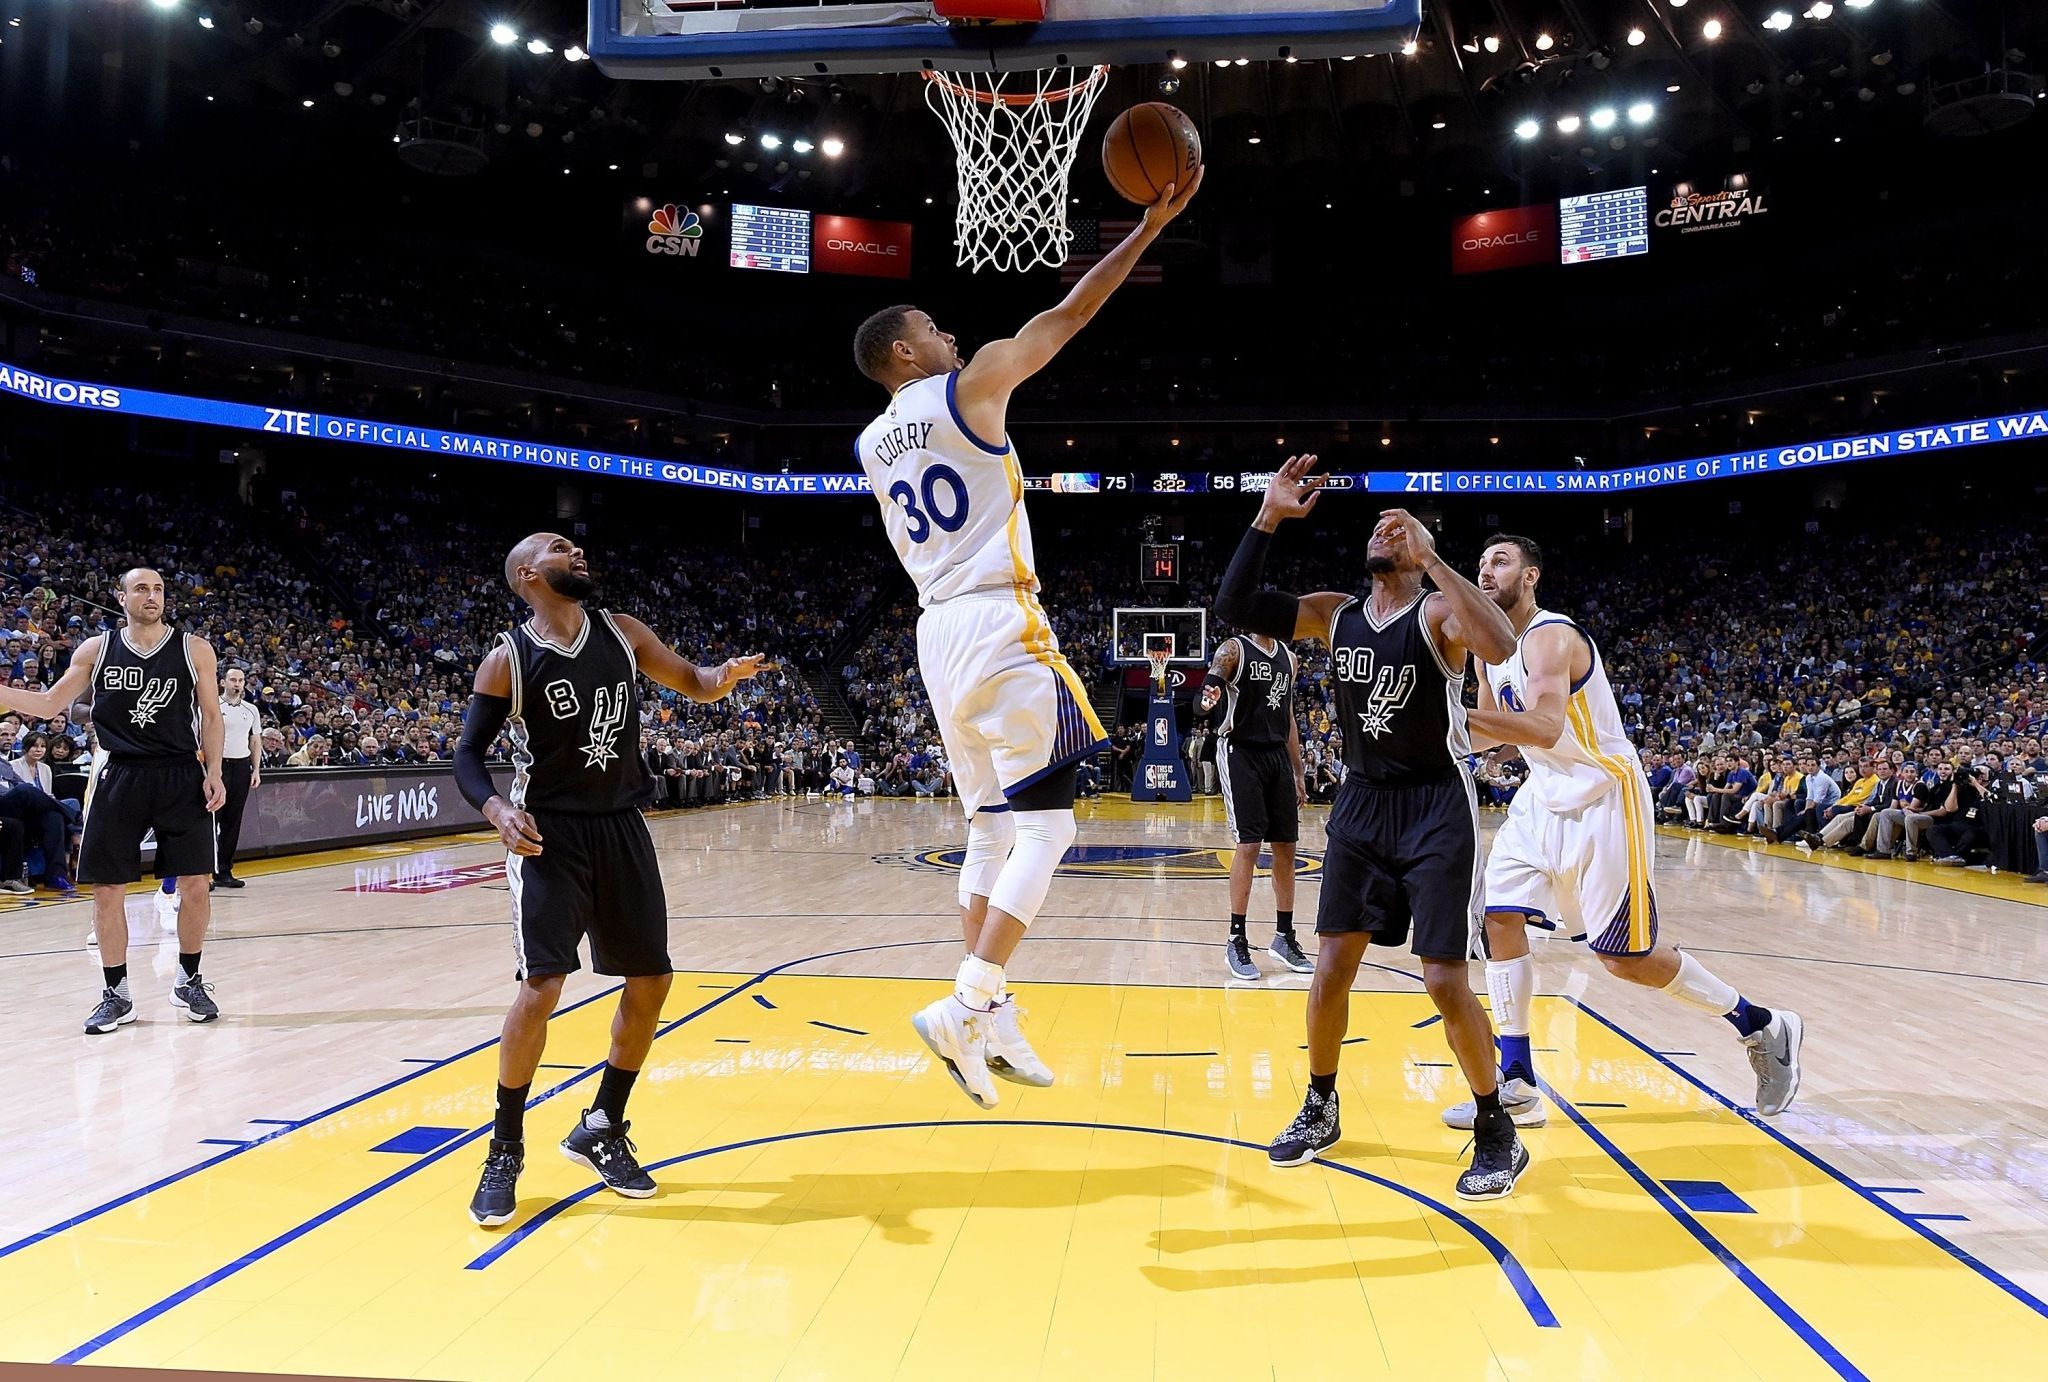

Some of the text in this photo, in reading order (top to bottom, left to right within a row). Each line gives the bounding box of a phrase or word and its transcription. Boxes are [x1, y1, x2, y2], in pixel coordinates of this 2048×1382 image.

[1654, 196, 1768, 227] CENTRAL
[646, 235, 700, 257] CSN
[827, 239, 898, 255] ORACLE
[1462, 230, 1539, 250] ORACLE
[263, 408, 311, 435] ZTE
[327, 420, 430, 448] OFFICIAL
[440, 435, 579, 467] SMARTPHONE
[588, 456, 612, 470] OF
[619, 459, 653, 476] THE
[662, 464, 746, 489] GOLDEN
[751, 476, 817, 492] STATE
[875, 422, 933, 467] CURRY
[1404, 415, 2048, 492] ZTE OFFICIAL SMARTPHONE OF THE GOLDEN STATE WA
[1035, 480, 1042, 488] 2
[1105, 476, 1127, 490] 75
[1153, 480, 1186, 492] 3:22
[1213, 476, 1234, 490] 56
[1329, 479, 1339, 487] TF
[888, 463, 970, 544] 30
[1155, 560, 1172, 577] 14
[1249, 661, 1272, 681] 12
[1335, 647, 1374, 683] 30
[104, 666, 143, 690] 20
[545, 679, 580, 720] 8
[397, 782, 438, 824] MÁS
